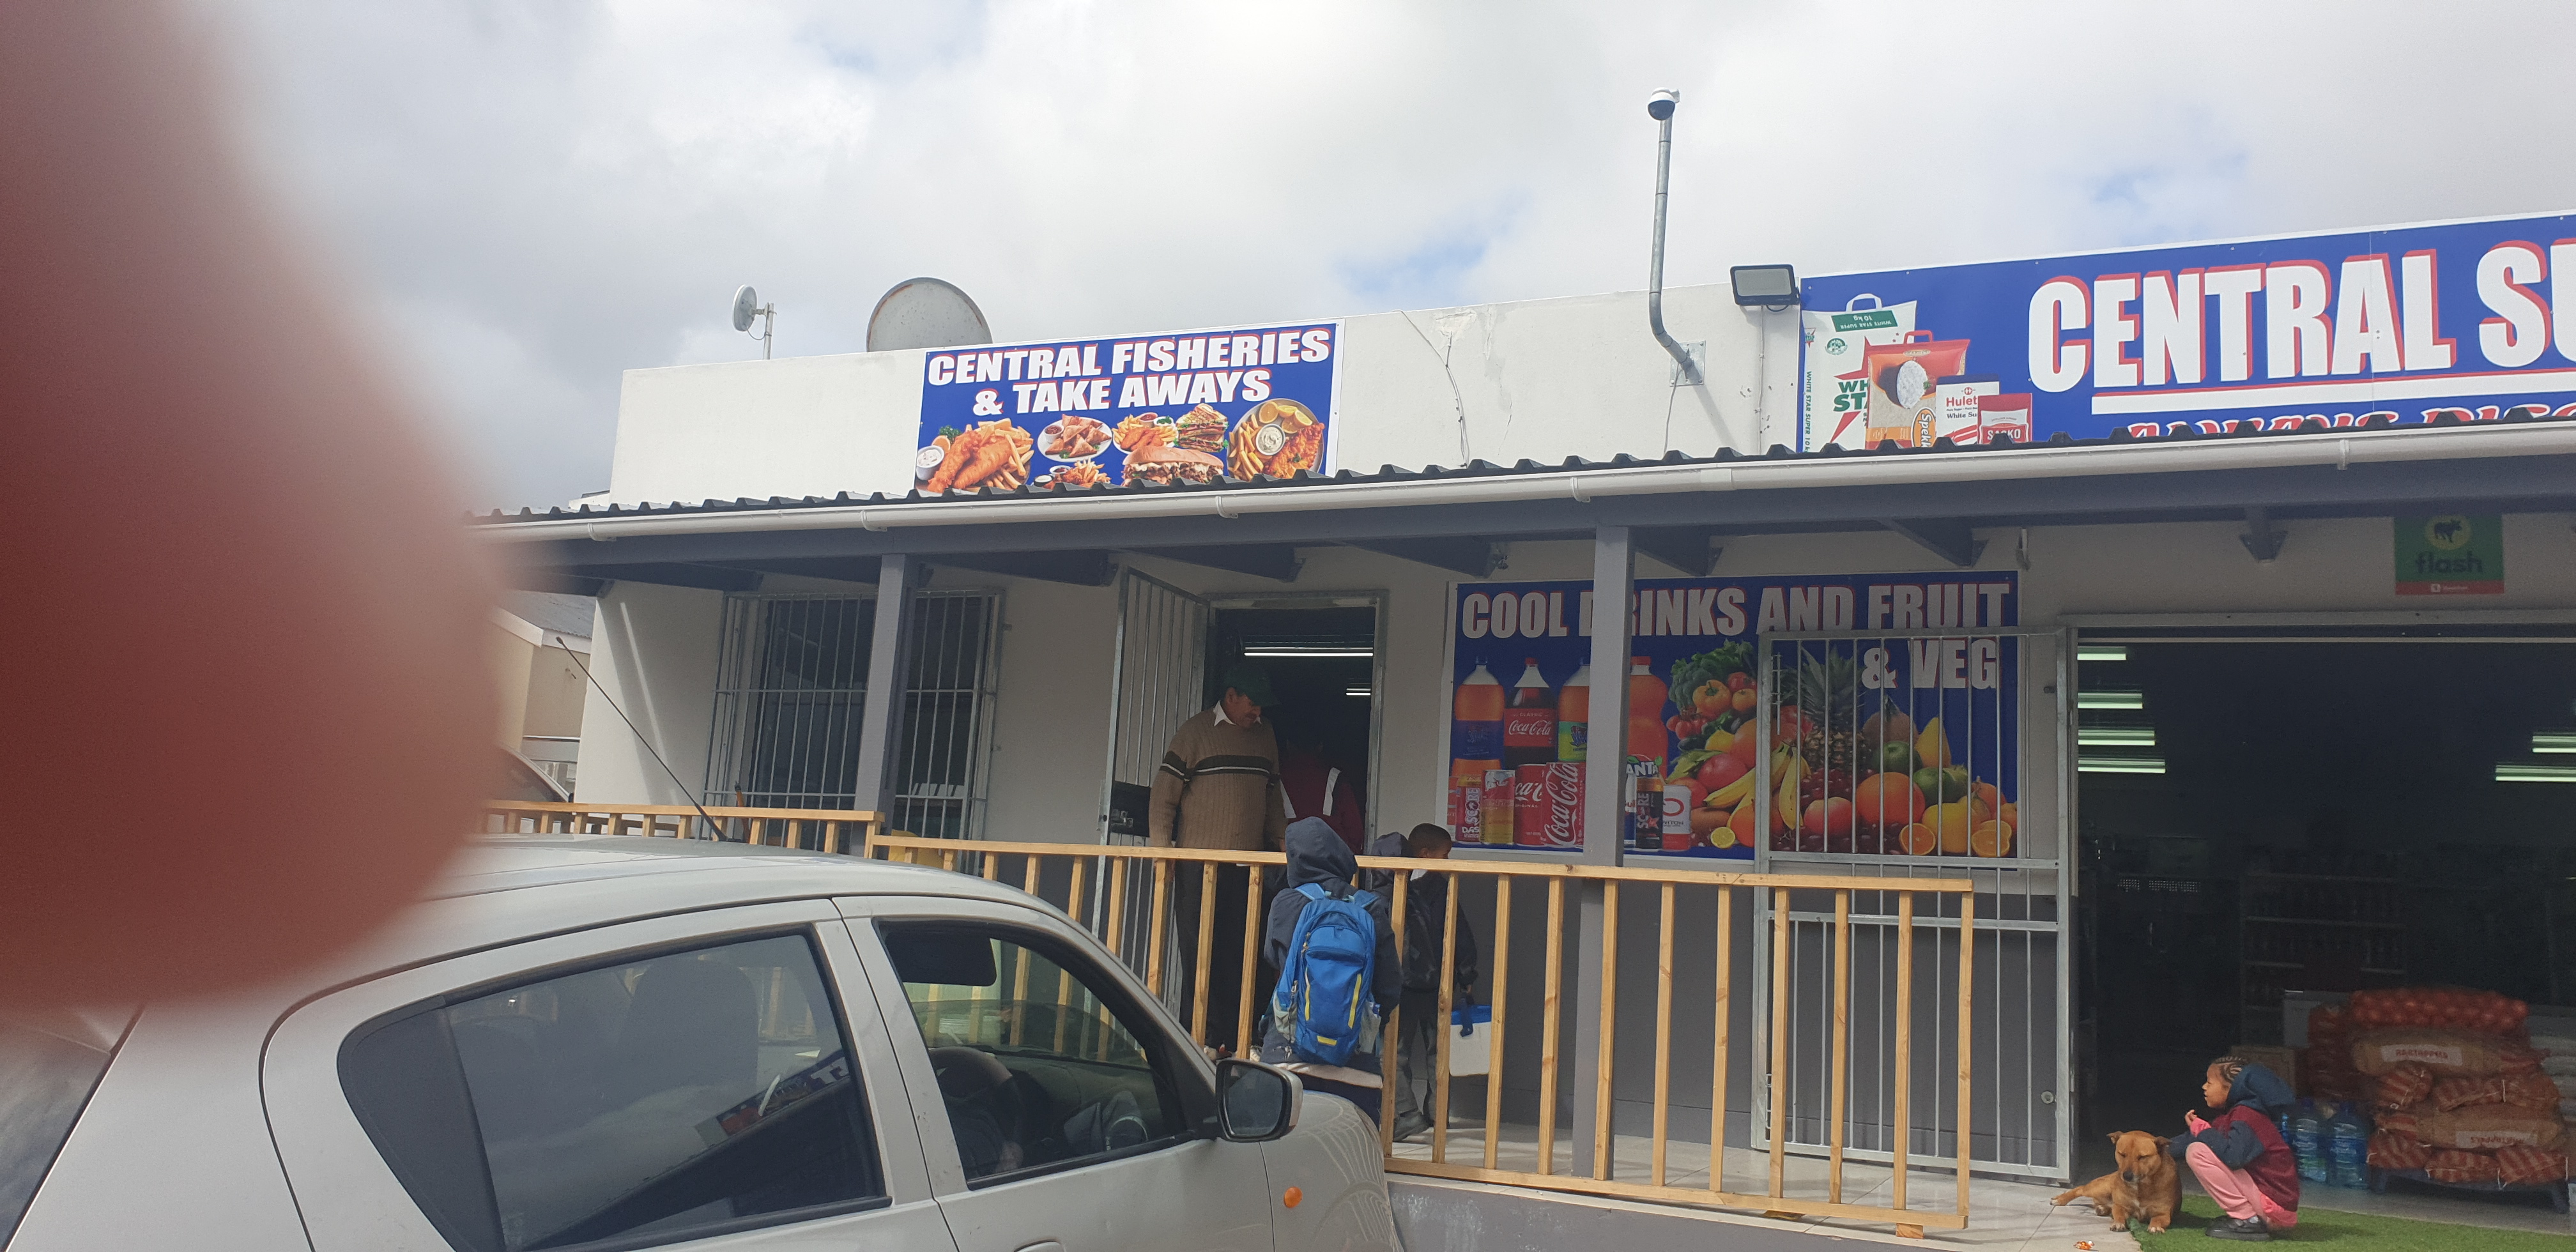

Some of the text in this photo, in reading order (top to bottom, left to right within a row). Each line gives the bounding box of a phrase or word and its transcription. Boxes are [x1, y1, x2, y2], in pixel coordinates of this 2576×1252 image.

[2028, 248, 2457, 392] CENTRAL
[928, 328, 1331, 386] CENTRAL FISHERIES
[973, 368, 1271, 415] & TAKE AWAYS
[2416, 550, 2483, 574] flash
[1462, 592, 1568, 638] COOL
[1756, 584, 1856, 634] AND
[1868, 582, 2011, 629] FRUIT
[1862, 637, 2001, 689] & VEG
